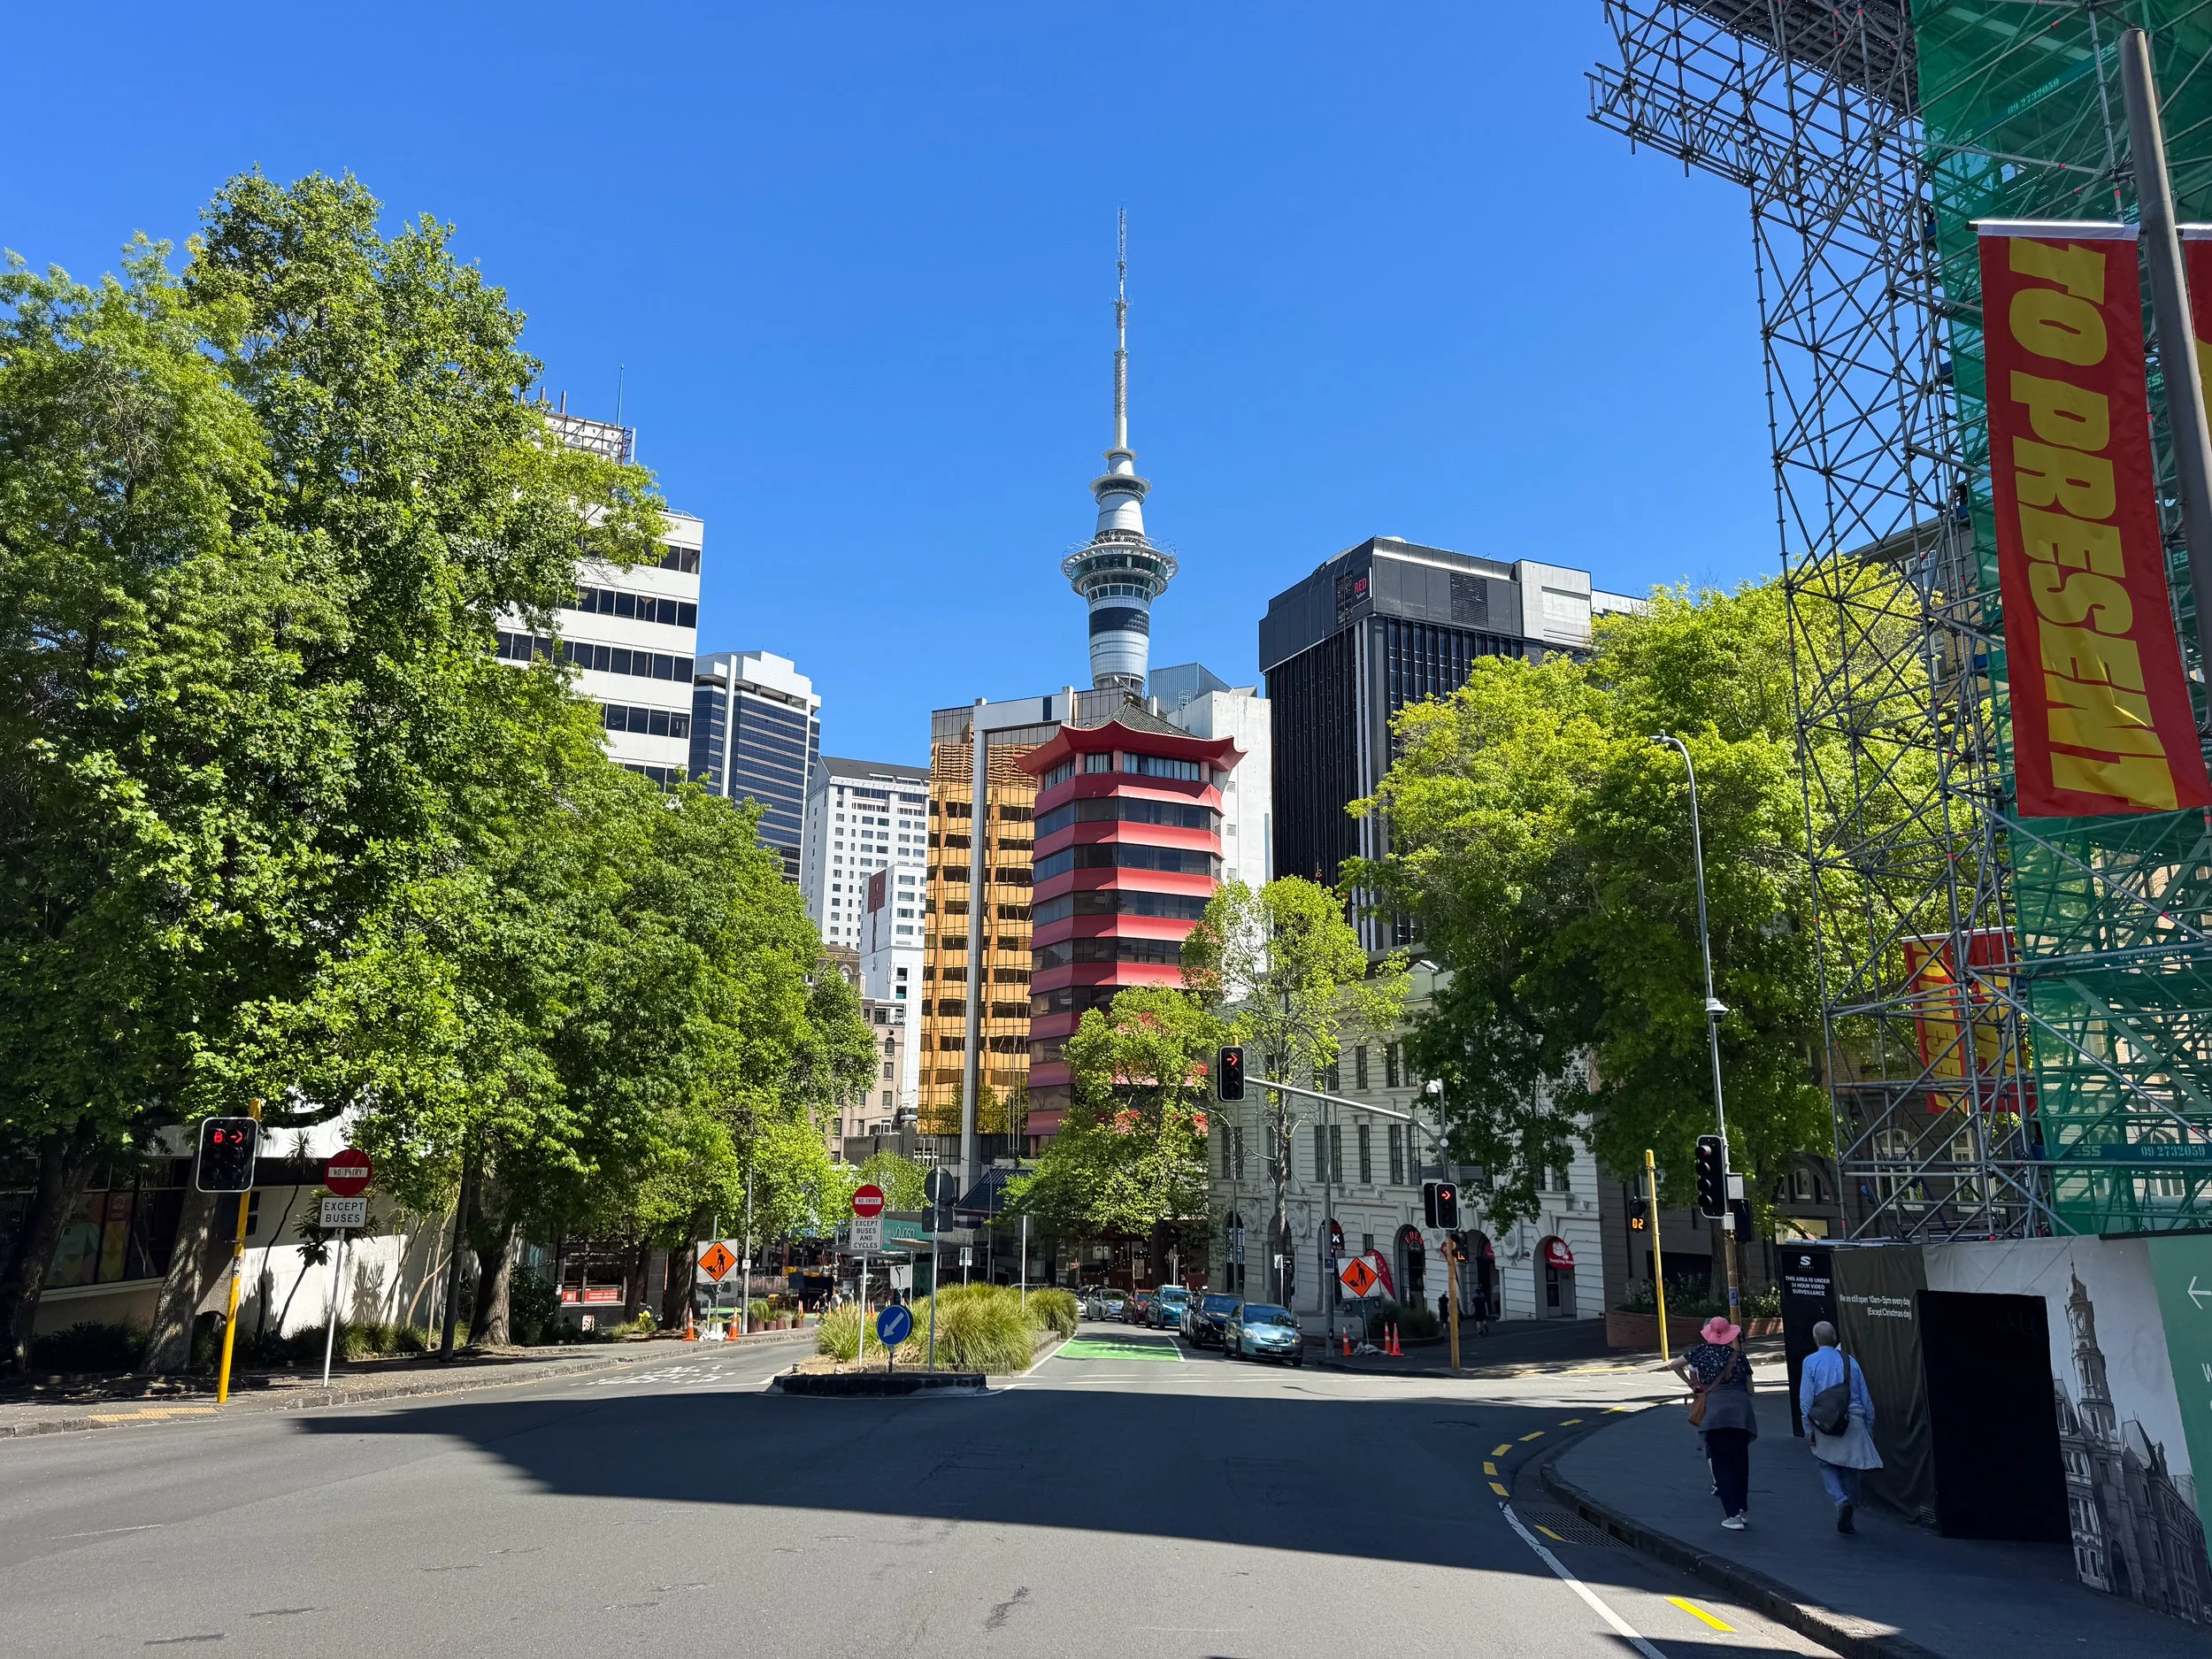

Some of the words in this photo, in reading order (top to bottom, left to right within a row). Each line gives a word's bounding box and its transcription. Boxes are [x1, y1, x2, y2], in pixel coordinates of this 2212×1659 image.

[2008, 103, 2019, 115] 09
[2009, 236, 2108, 366] TO
[1355, 577, 1367, 594] RED
[2010, 369, 2178, 810] PRESENT
[2141, 1145, 2154, 1156] 09
[2157, 1145, 2206, 1157] 2732059
[324, 1202, 365, 1211] EXCEPT
[325, 1214, 360, 1223] BUSES
[1858, 1296, 1869, 1305] open
[1892, 1298, 1903, 1308] every
[1902, 1297, 1911, 1308] day
[1882, 1308, 1903, 1317] Christmas
